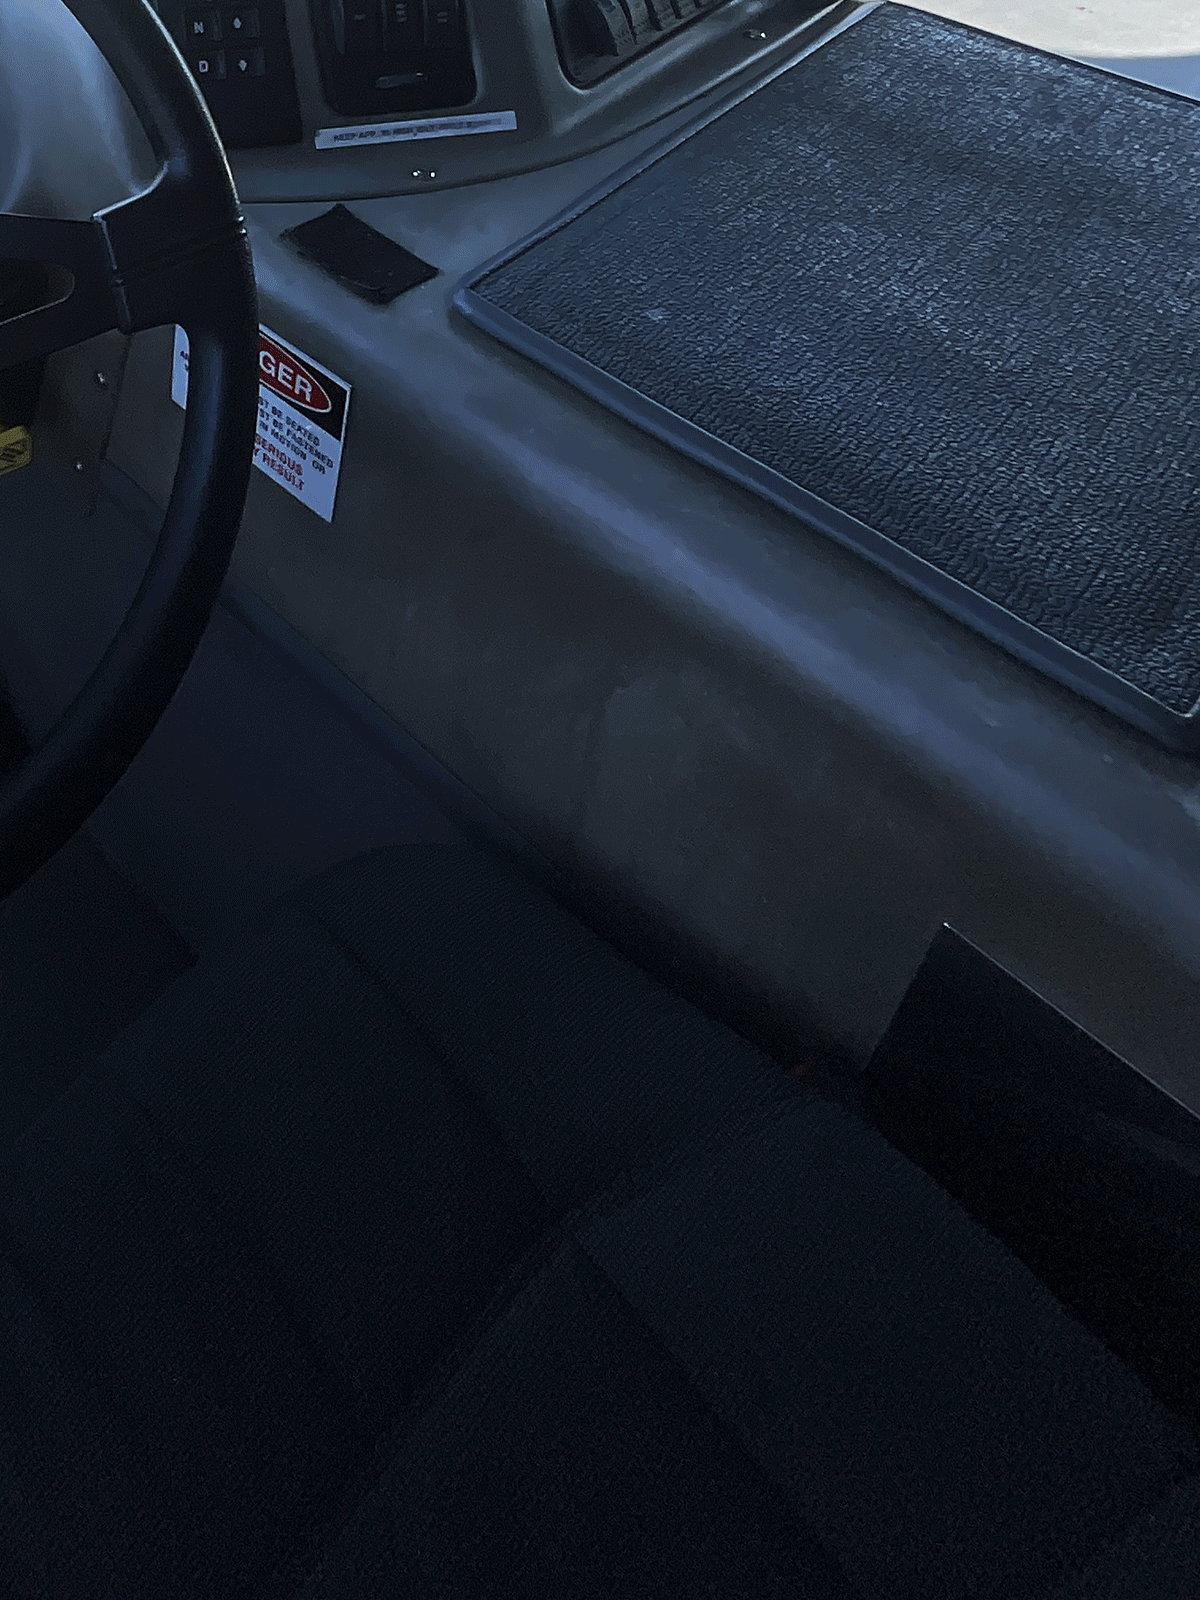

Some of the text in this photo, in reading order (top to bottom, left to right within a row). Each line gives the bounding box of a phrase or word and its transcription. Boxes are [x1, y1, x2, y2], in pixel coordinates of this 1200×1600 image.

[194, 21, 204, 34] N
[259, 350, 313, 403] GER
[272, 418, 284, 433] BE
[286, 428, 334, 469] FASTENED
[285, 415, 320, 447] SEATED
[254, 436, 303, 476] SERIOUS
[262, 452, 305, 491] RESULT
[270, 428, 307, 461] MOTION
[311, 459, 326, 475] OR
